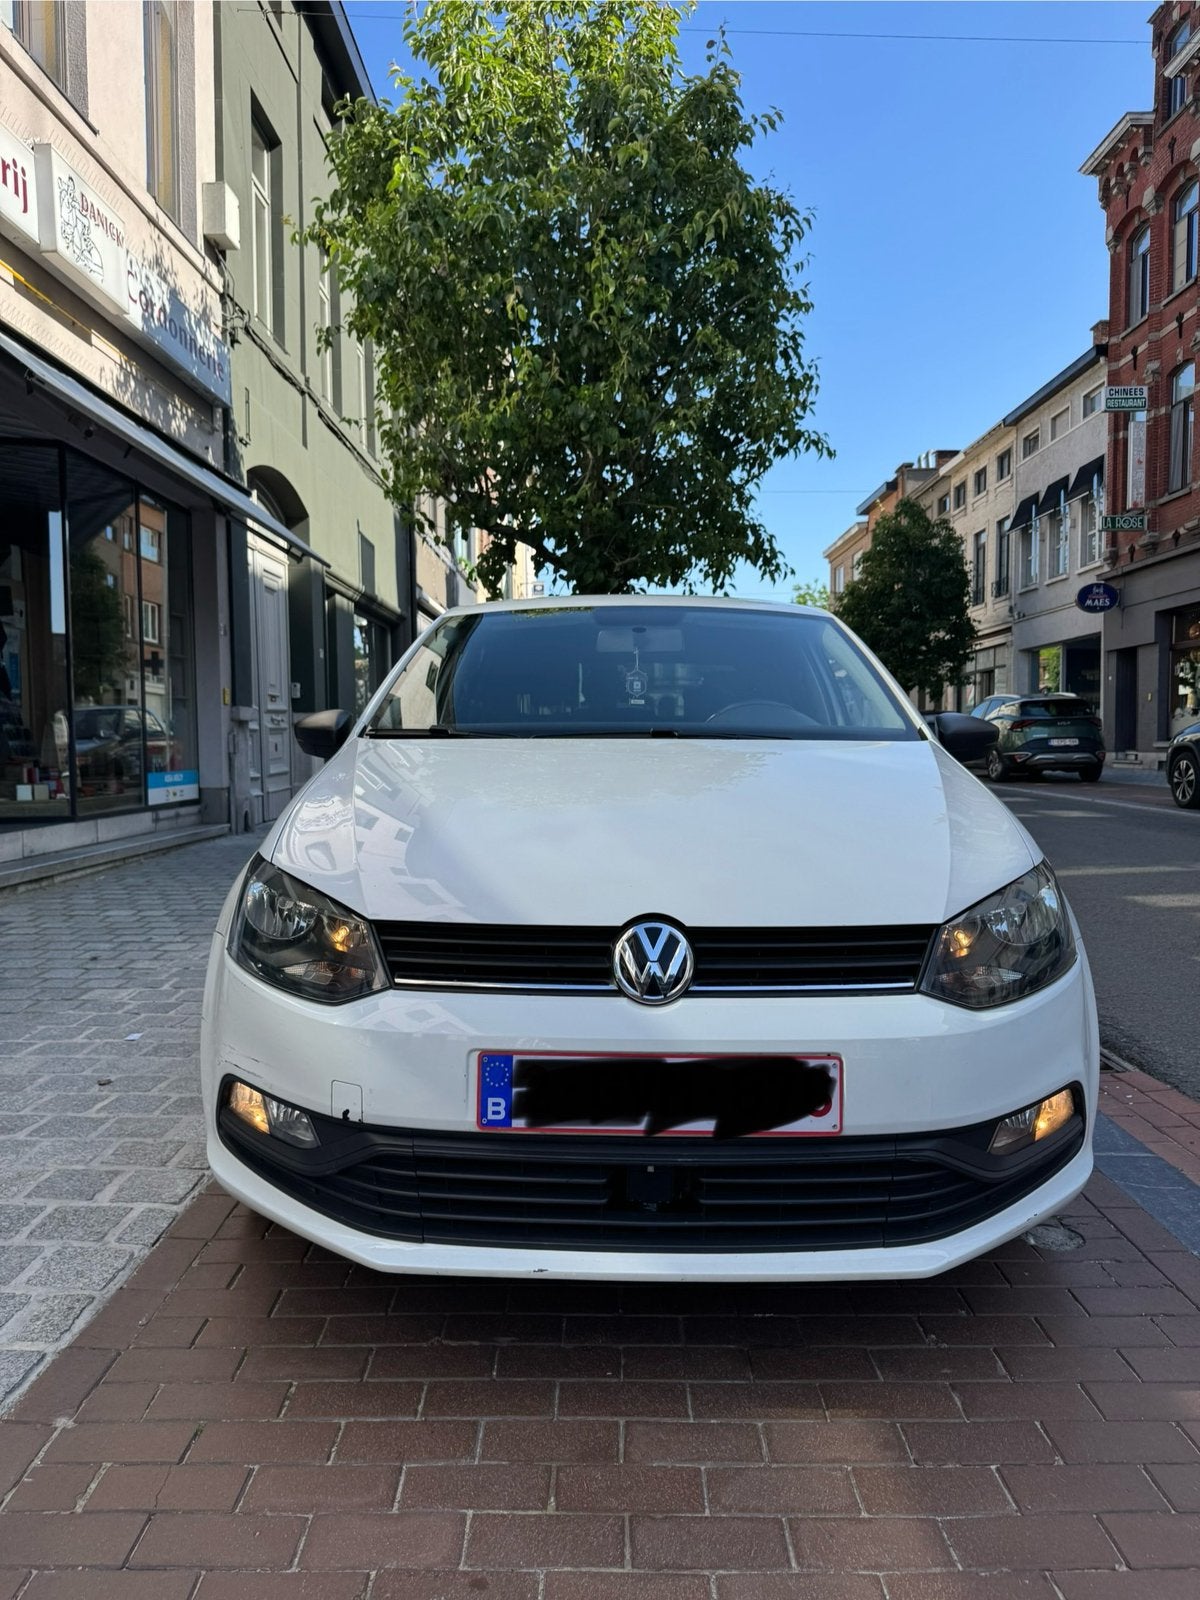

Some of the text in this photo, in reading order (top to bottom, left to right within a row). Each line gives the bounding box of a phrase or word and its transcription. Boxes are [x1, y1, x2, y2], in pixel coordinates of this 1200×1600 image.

[1108, 387, 1144, 397] CHINEES
[1106, 398, 1146, 408] RESTAURANT
[1102, 516, 1143, 529] LA ROSE
[1084, 598, 1110, 606] MAES
[487, 1097, 506, 1120] B
